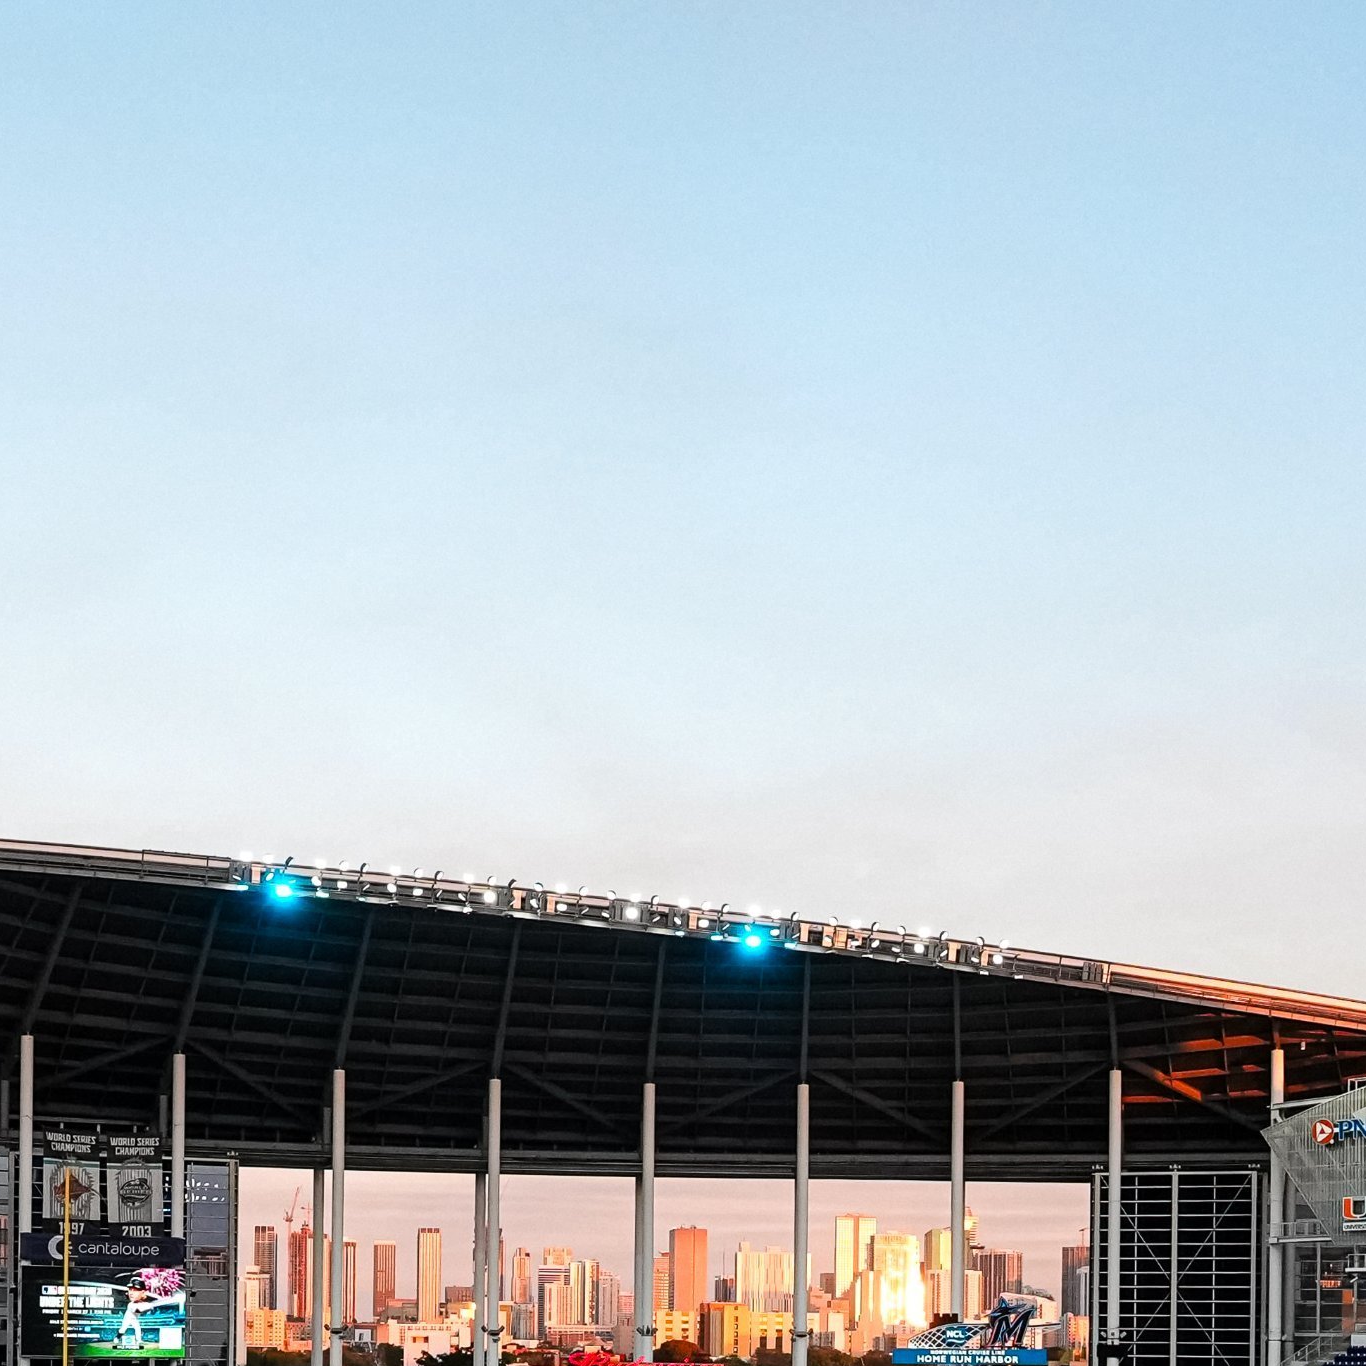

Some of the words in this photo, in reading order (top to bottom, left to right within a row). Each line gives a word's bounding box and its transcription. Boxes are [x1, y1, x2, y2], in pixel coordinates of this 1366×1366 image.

[46, 1131, 71, 1142] WORLD
[73, 1134, 97, 1144] SERIES
[110, 1137, 136, 1146] WORLD
[137, 1137, 160, 1146] SERIES
[51, 1142, 91, 1153] CHAMPIONS
[115, 1147, 155, 1156] CHAMPIONS
[59, 1222, 84, 1235] 197
[122, 1226, 152, 1237] 2003
[79, 1242, 160, 1259] cantaloupe
[946, 1330, 965, 1338] NCL
[917, 1355, 946, 1363] HOME
[950, 1355, 971, 1363] RUN
[976, 1355, 1018, 1364] HARBOR
